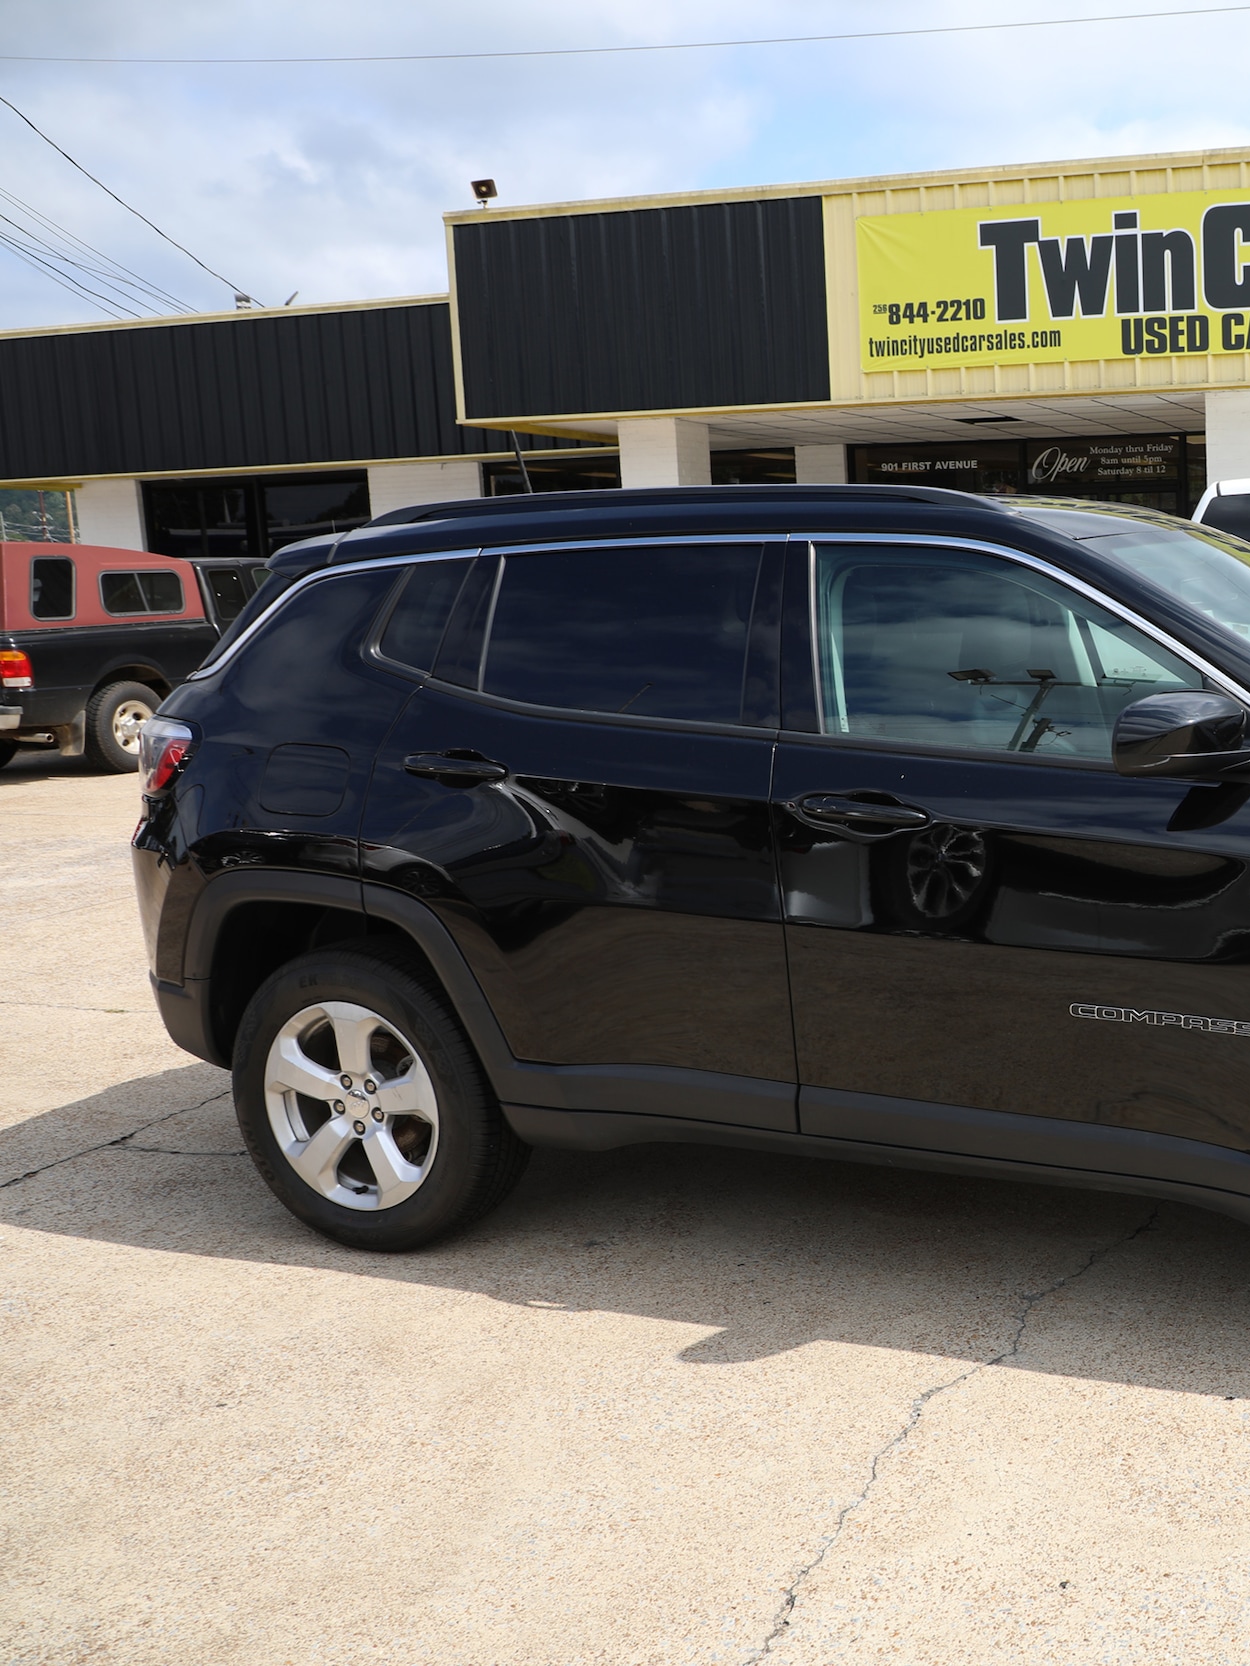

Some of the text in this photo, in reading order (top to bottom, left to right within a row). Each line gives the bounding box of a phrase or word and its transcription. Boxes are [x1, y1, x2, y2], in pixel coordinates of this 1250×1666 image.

[888, 298, 985, 325] 844-2210
[869, 329, 1061, 359] twincityusedcarsales.com
[1121, 314, 1209, 355] USED
[1089, 443, 1174, 455] Monday thru Friday
[881, 460, 978, 472] 901 FIRST AVENUE
[1032, 446, 1091, 482] Open
[1100, 455, 1163, 465] 8am until 5pm
[1097, 464, 1166, 476] Saturday 8 til 12
